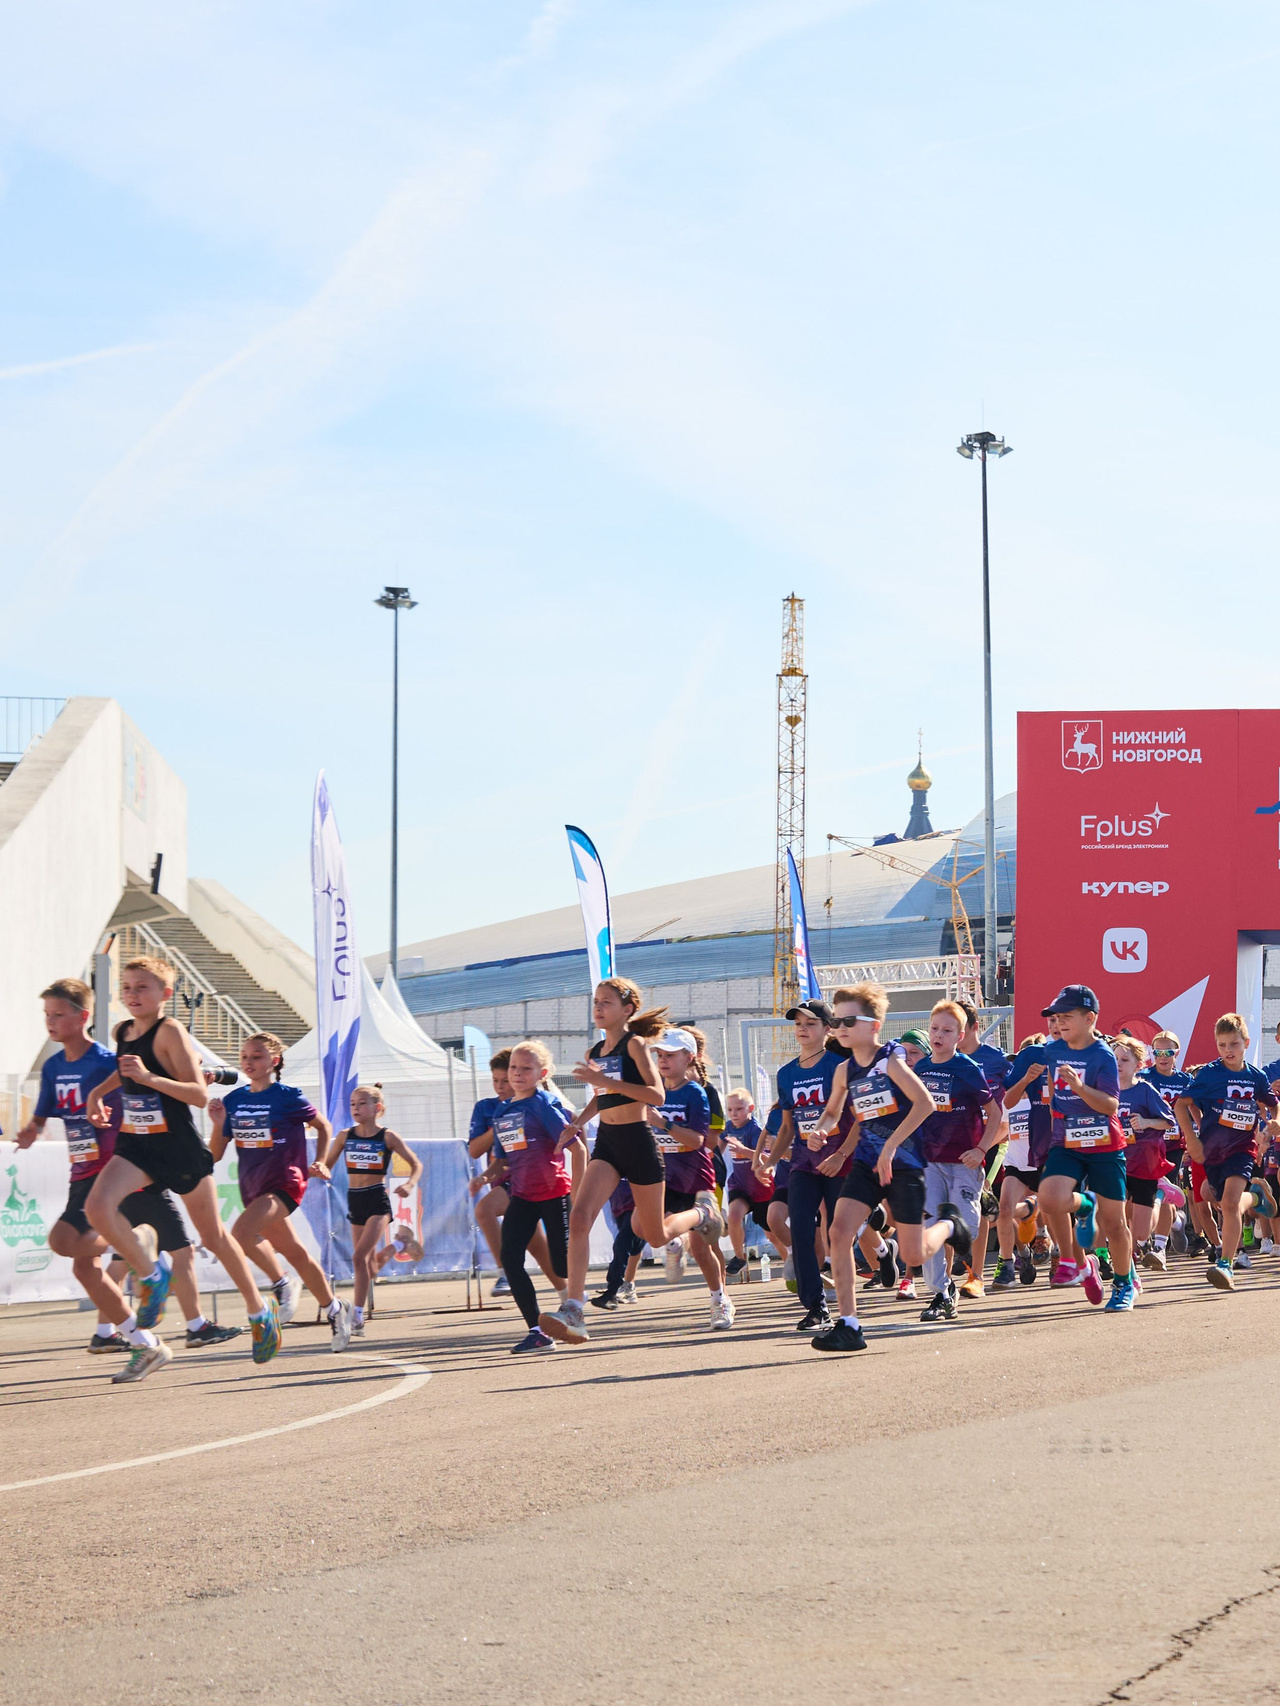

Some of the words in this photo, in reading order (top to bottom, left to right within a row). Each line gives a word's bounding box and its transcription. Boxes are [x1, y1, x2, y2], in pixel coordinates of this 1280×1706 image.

[1112, 728, 1186, 744] НИЖНИЙ
[1112, 749, 1202, 763] НОВГОРОД
[1080, 815, 1153, 842] Fplus
[1110, 941, 1140, 961] VK
[1071, 1130, 1104, 1138] 10453
